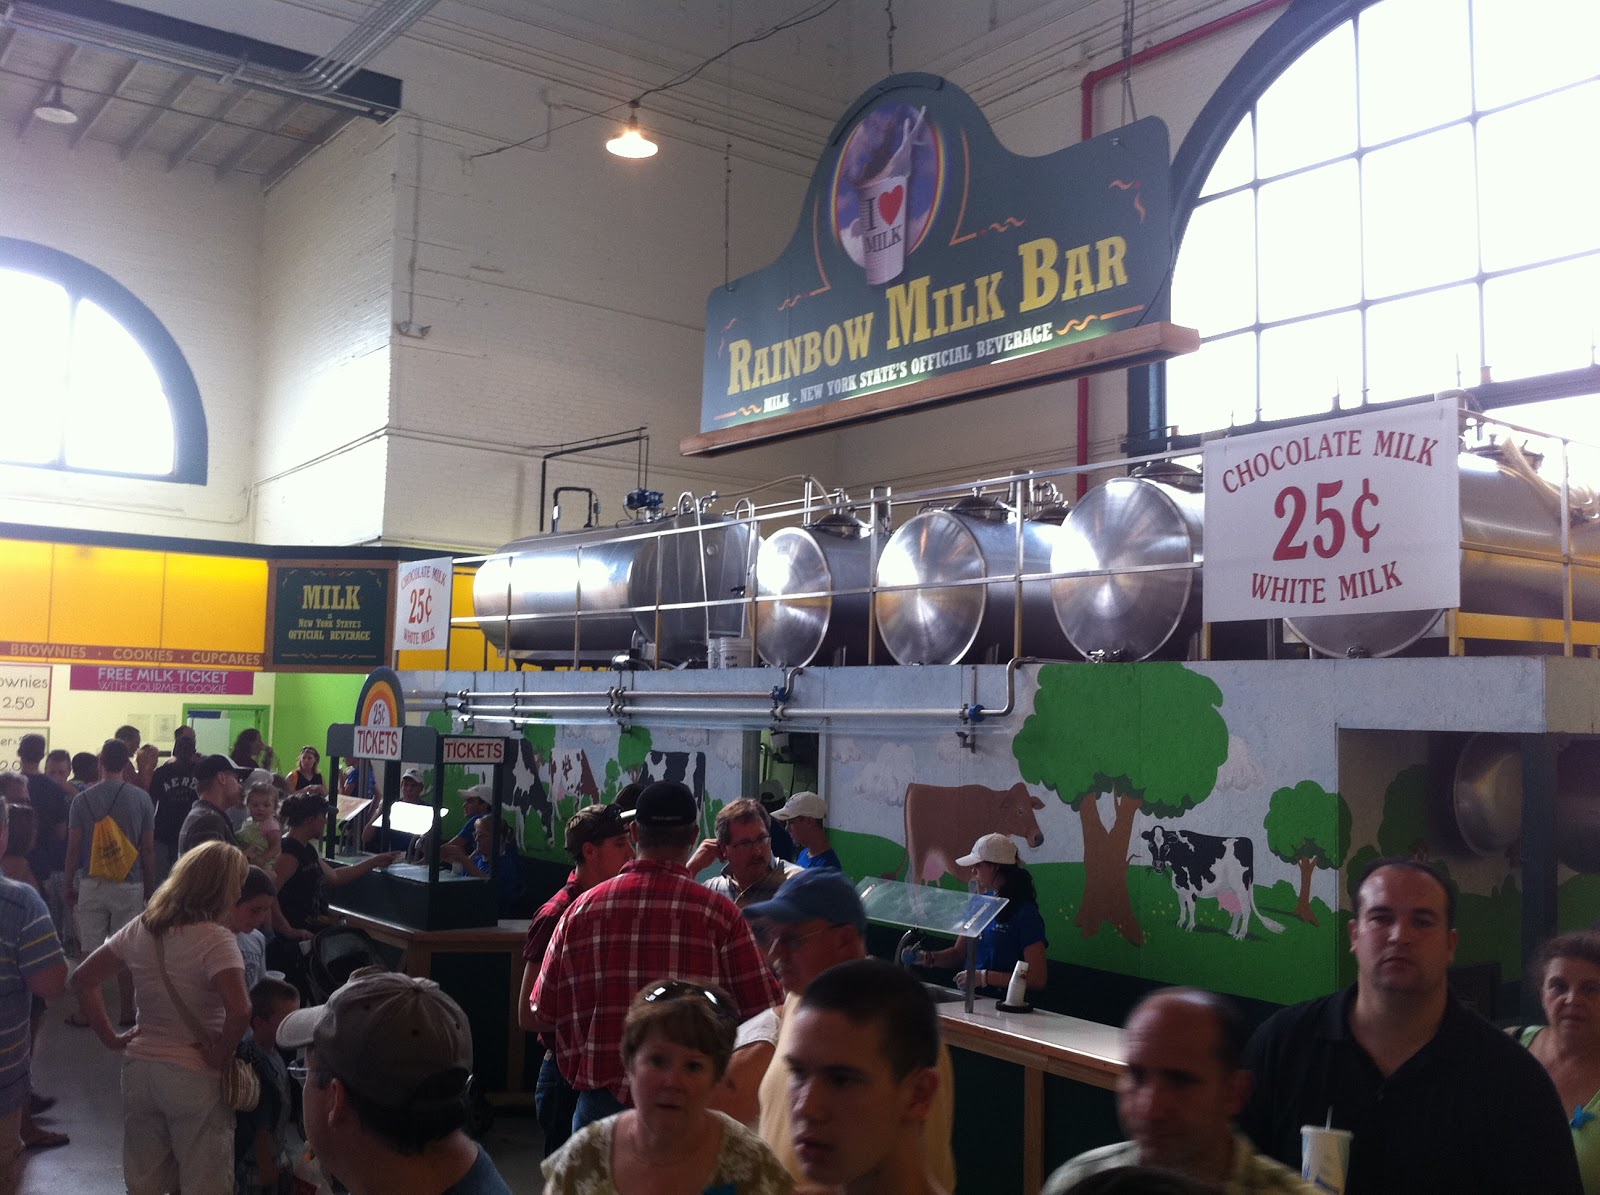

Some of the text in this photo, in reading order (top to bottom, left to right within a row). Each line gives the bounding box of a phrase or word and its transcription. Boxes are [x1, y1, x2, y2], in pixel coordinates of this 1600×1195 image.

[865, 224, 902, 254] MILK
[727, 235, 1129, 397] RAINBOW MILK BAR
[763, 392, 790, 413] MILK
[800, 382, 824, 404] NEW
[827, 375, 858, 397] YORK
[860, 360, 908, 389] STATE'S
[911, 344, 973, 375] OFFICIAL
[976, 322, 1053, 359] BEVERAGE
[1222, 430, 1439, 493] CHOCOLATE MILK
[1272, 478, 1380, 561] 25¢
[401, 566, 447, 590] CHOCOLATE MILK
[1252, 561, 1403, 604] WHITE MILK
[302, 585, 361, 610] MILK
[409, 588, 432, 624] 25¢
[298, 618, 313, 628] NEW
[315, 618, 334, 628] YORK
[288, 630, 371, 641] OFFICIAL BEVERAGE
[404, 627, 435, 644] WHITE MILK
[10, 643, 261, 666] BROWNIES COOKIES CUPCAKES
[98, 667, 229, 683] FREE MILK TICKET
[98, 681, 227, 694] WITH GOURMET COOKIE
[3, 696, 35, 710] 2.50
[373, 703, 385, 725] 25¢
[357, 730, 398, 756] TICKETS
[445, 742, 502, 759] TICKETS
